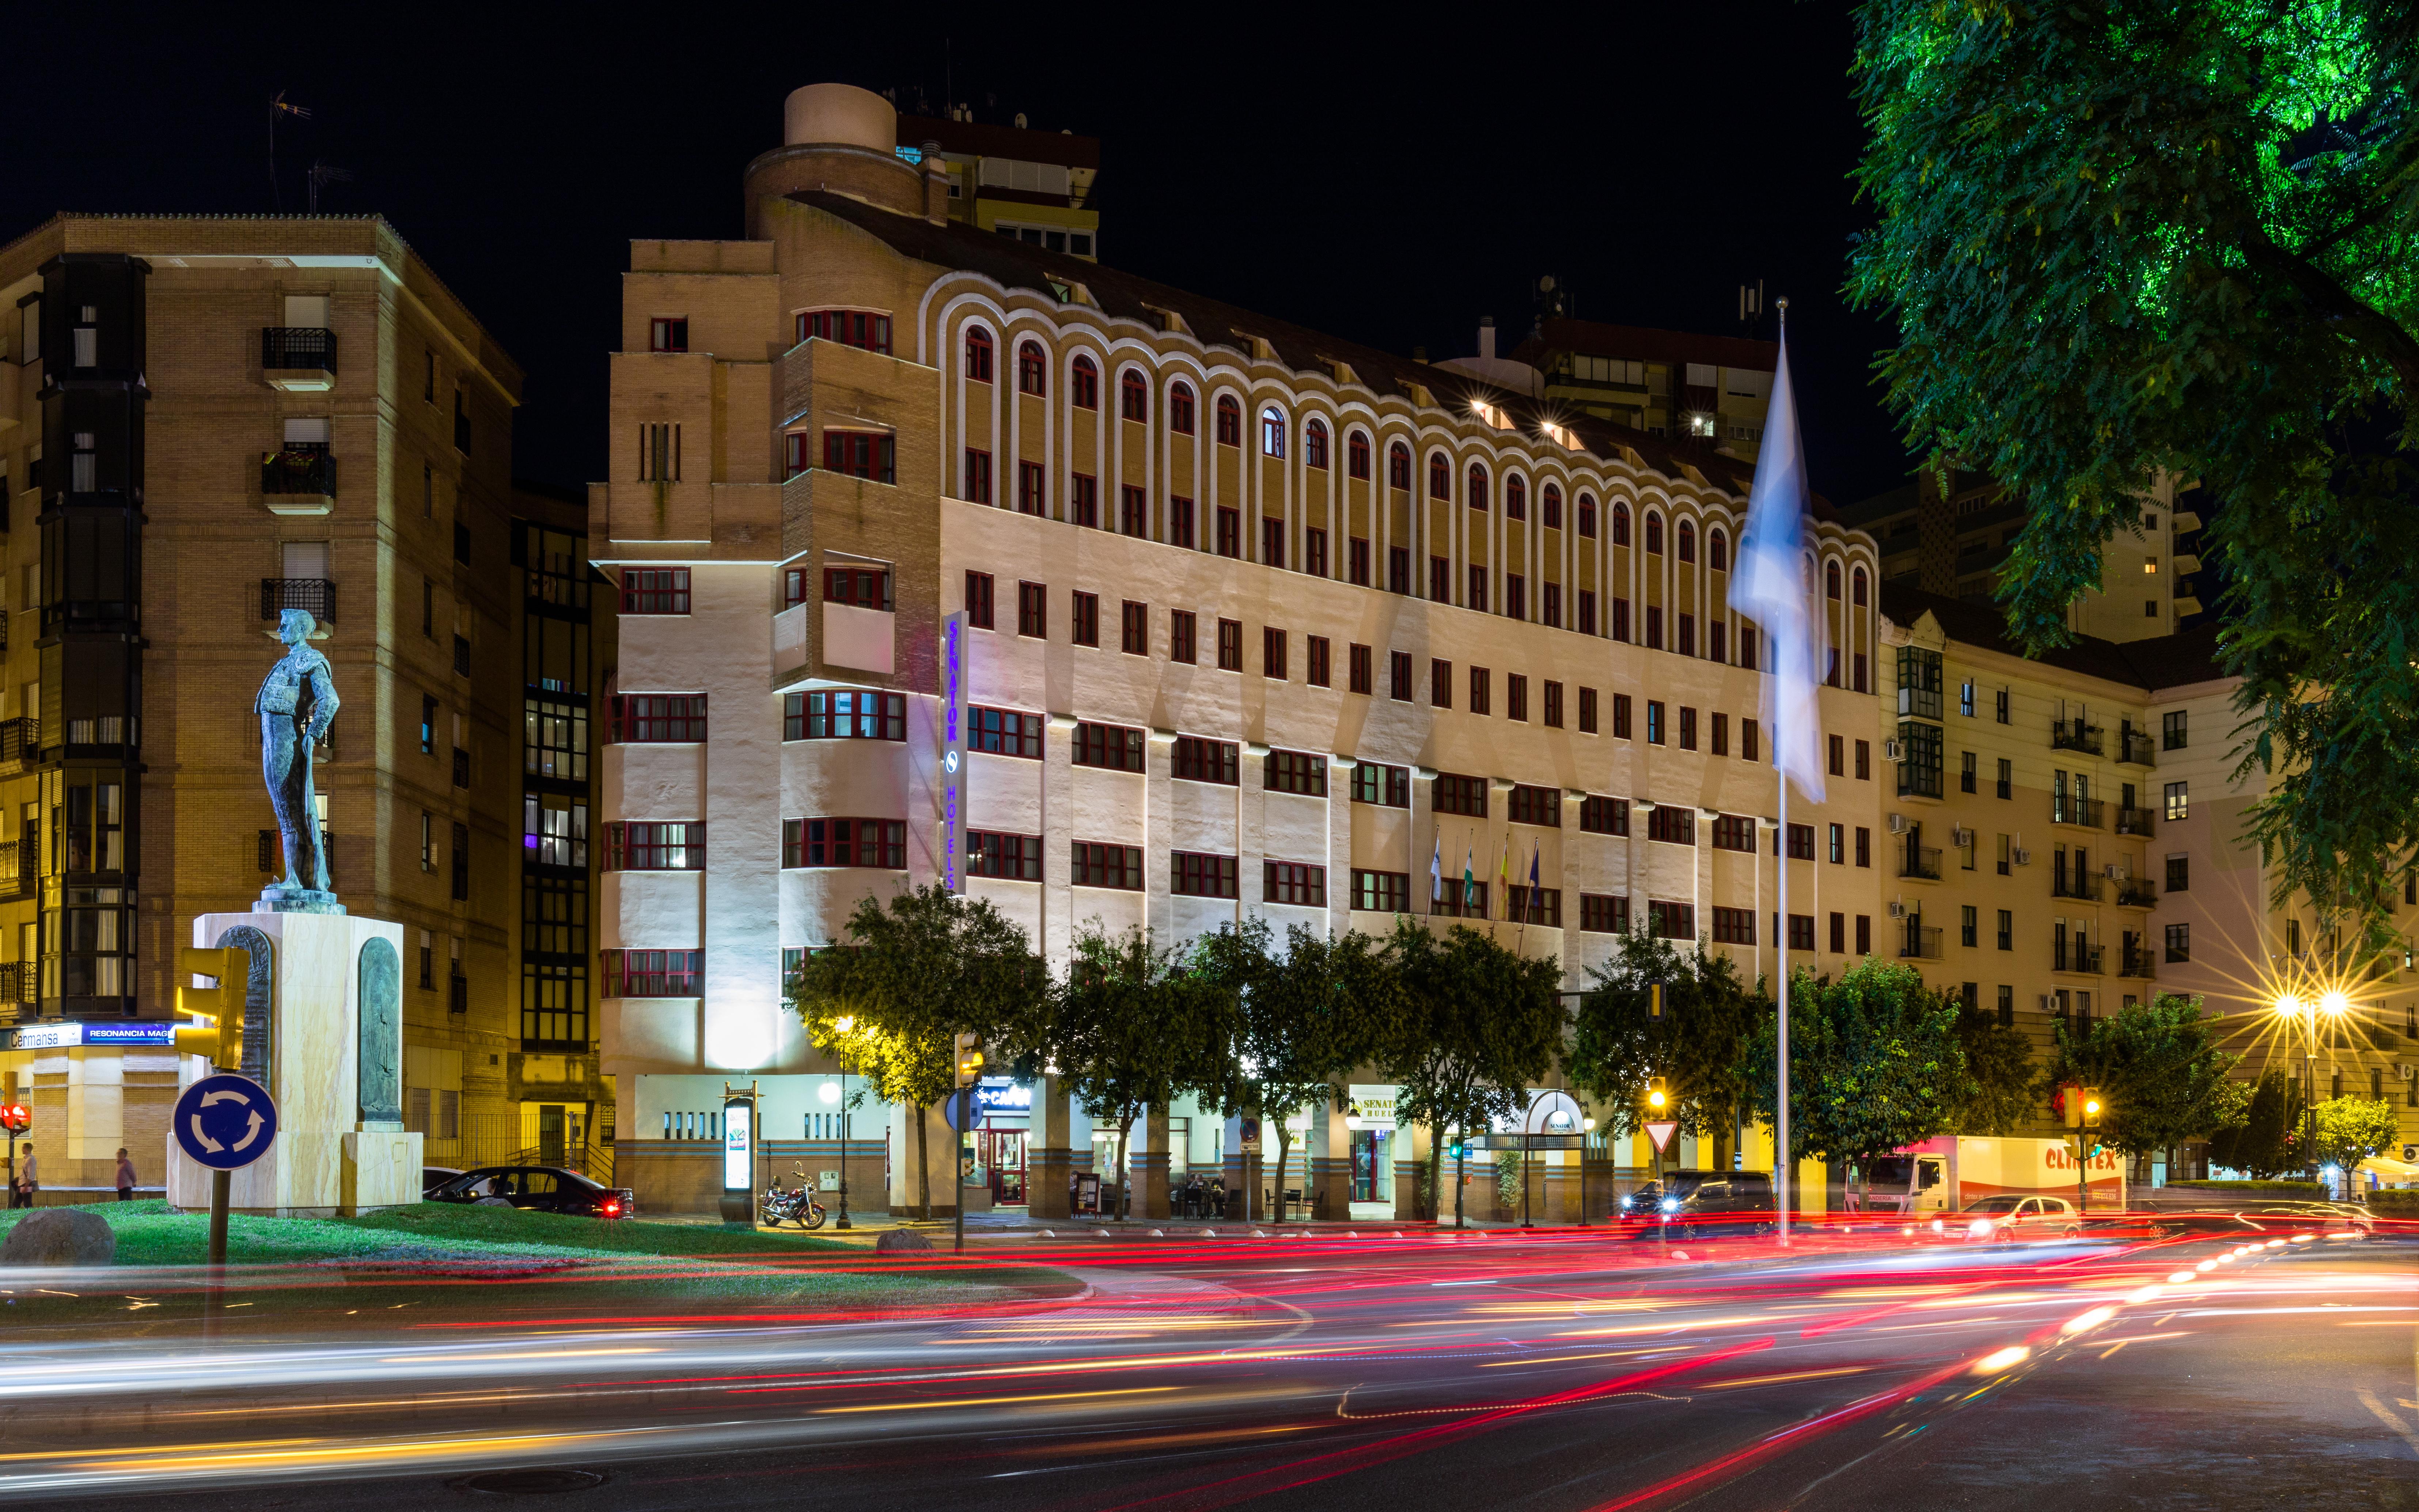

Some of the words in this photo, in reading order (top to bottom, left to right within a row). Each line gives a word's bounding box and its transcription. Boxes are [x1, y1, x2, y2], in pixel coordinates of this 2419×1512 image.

[947, 620, 958, 742] SENATOR
[947, 784, 956, 889] HOTELS
[11, 1030, 58, 1047] Cermahsa
